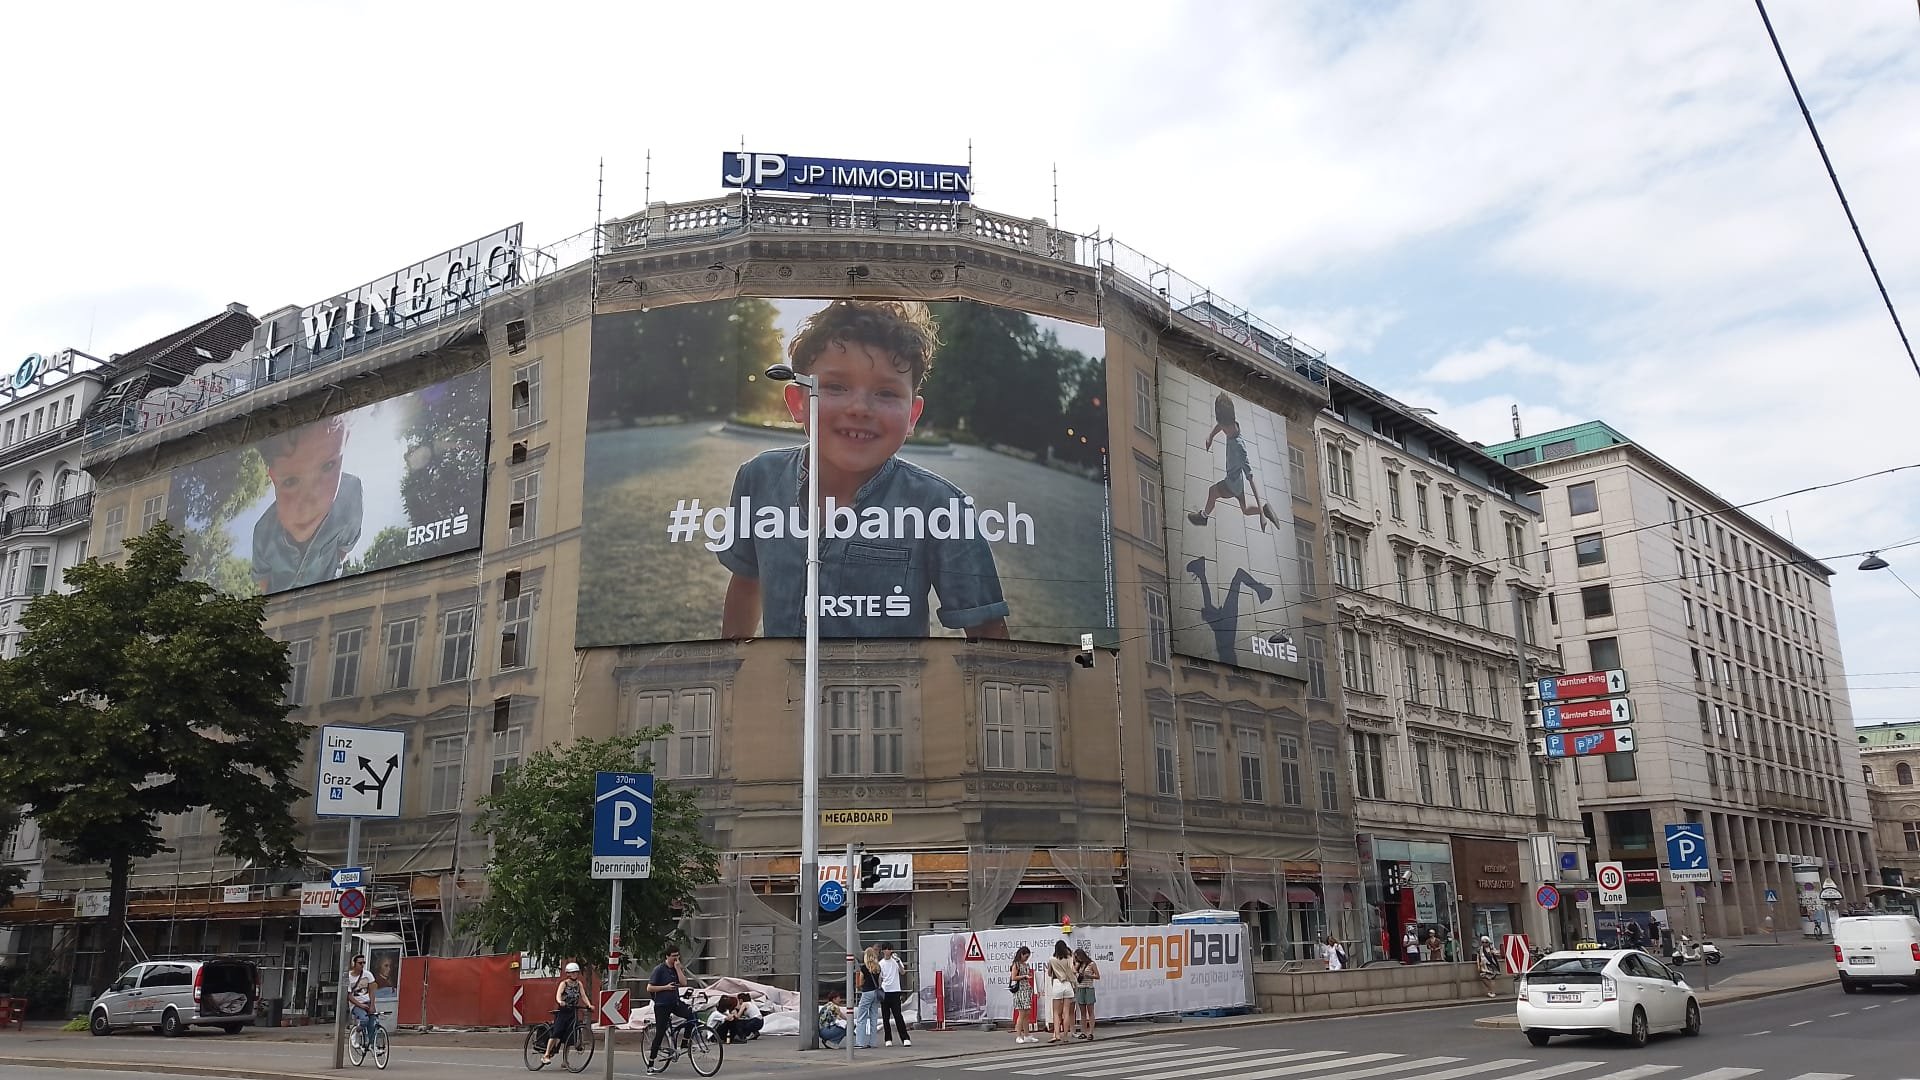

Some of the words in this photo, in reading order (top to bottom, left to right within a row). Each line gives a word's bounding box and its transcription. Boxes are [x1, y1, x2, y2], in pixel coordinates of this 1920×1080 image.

[725, 154, 786, 185] JP
[794, 165, 825, 184] JP
[832, 166, 970, 191] IMMOBILIEN
[302, 240, 519, 349] WINEGG
[666, 496, 1036, 551] #glaubandich
[407, 518, 451, 546] ERSTE
[805, 594, 882, 617] RSTE
[1252, 635, 1286, 661] ERSTE
[1557, 676, 1588, 687] Kärntner
[1589, 675, 1606, 683] Ring
[1561, 710, 1588, 720] Kärntner
[1589, 708, 1611, 717] Straße
[328, 735, 353, 748] Linz
[334, 751, 345, 762] A1
[323, 772, 352, 785] Graz
[615, 775, 636, 785] 370m
[331, 788, 342, 799] A2
[825, 812, 889, 823] MEGABOARD
[594, 861, 649, 875] Opernringhof
[1604, 872, 1616, 884] 30
[1603, 892, 1623, 902] Zone
[986, 941, 998, 950] IHR
[1119, 928, 1240, 980] zinglbau
